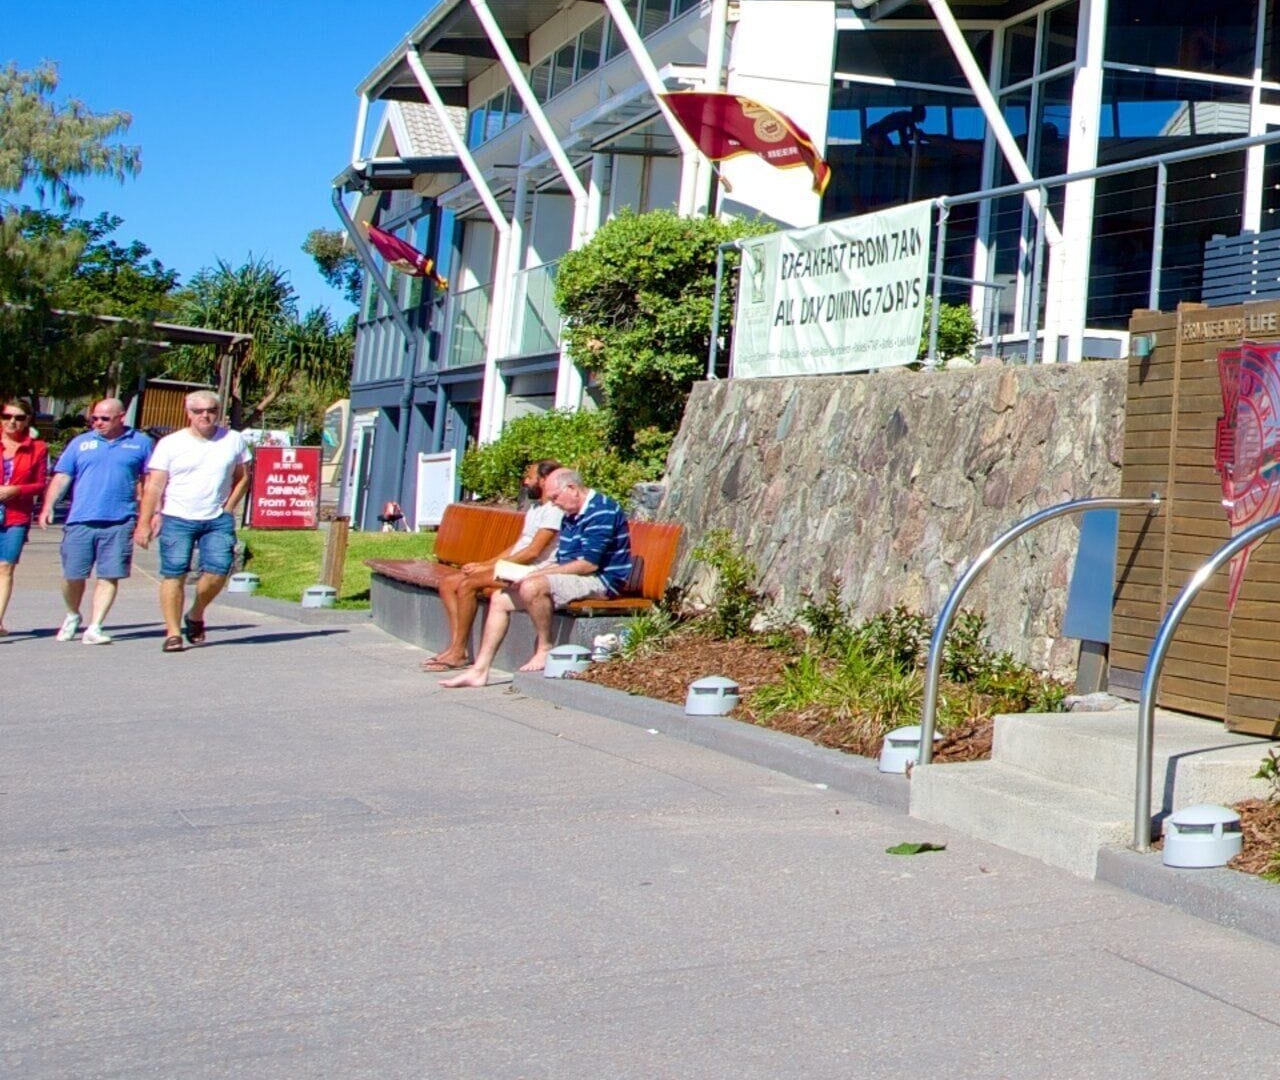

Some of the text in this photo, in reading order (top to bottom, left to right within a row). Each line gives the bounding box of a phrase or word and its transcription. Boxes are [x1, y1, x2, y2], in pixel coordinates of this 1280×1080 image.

[767, 146, 799, 158] BEER
[781, 244, 847, 280] BREAKFAST
[849, 234, 889, 269] FROM
[774, 299, 794, 327] ALL
[800, 295, 824, 325] DAY
[826, 287, 871, 322] DINING
[1250, 312, 1278, 334] LIFE
[80, 440, 98, 451] 08
[266, 474, 310, 484] ALL DAY
[266, 486, 308, 495] DINING
[258, 498, 314, 507] From 7am
[266, 509, 284, 518] Days
